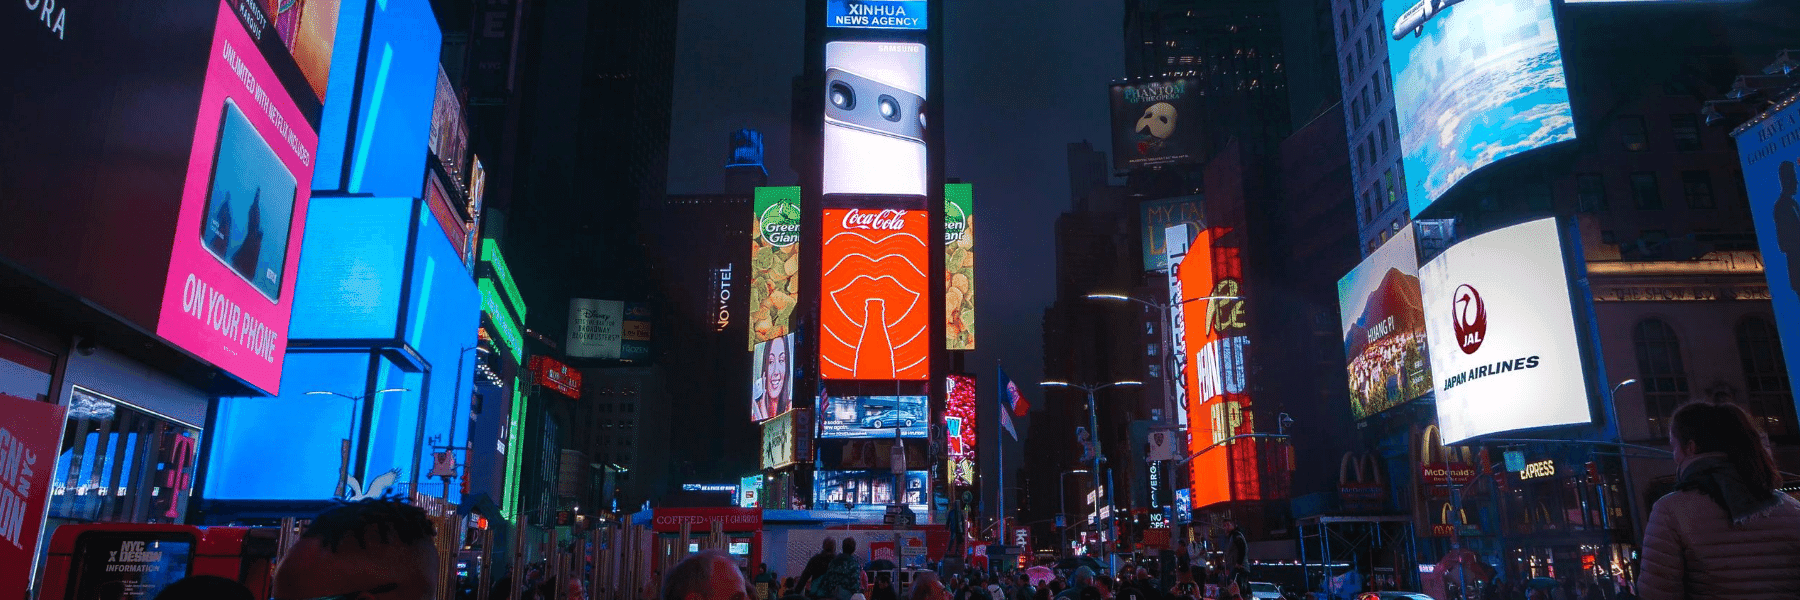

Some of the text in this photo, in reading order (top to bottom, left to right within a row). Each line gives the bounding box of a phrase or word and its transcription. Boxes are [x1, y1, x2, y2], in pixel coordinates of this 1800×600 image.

[848, 4, 906, 16] XINHUA
[239, 3, 262, 40] MARQUIS
[835, 16, 919, 26] NEWS AGENCY
[878, 45, 920, 53] SAMSUNG
[1124, 83, 1186, 100] PHANTOM
[222, 39, 310, 167] UNLIMITED WITH NETFLIX INCLUDED
[842, 208, 909, 230] Coca-Cola
[716, 263, 732, 332] NOVOTEL
[183, 273, 278, 364] ON YOUR PHONE
[1367, 318, 1389, 344] HUANG
[1463, 331, 1482, 348] JAL
[1444, 371, 1467, 391] JAPAN
[1468, 355, 1540, 382] AIRLINES
[1424, 468, 1475, 478] McDonald's
[121, 540, 146, 552] NYC
[108, 550, 163, 562] X DESIGN
[105, 564, 161, 572] INFORMATION
